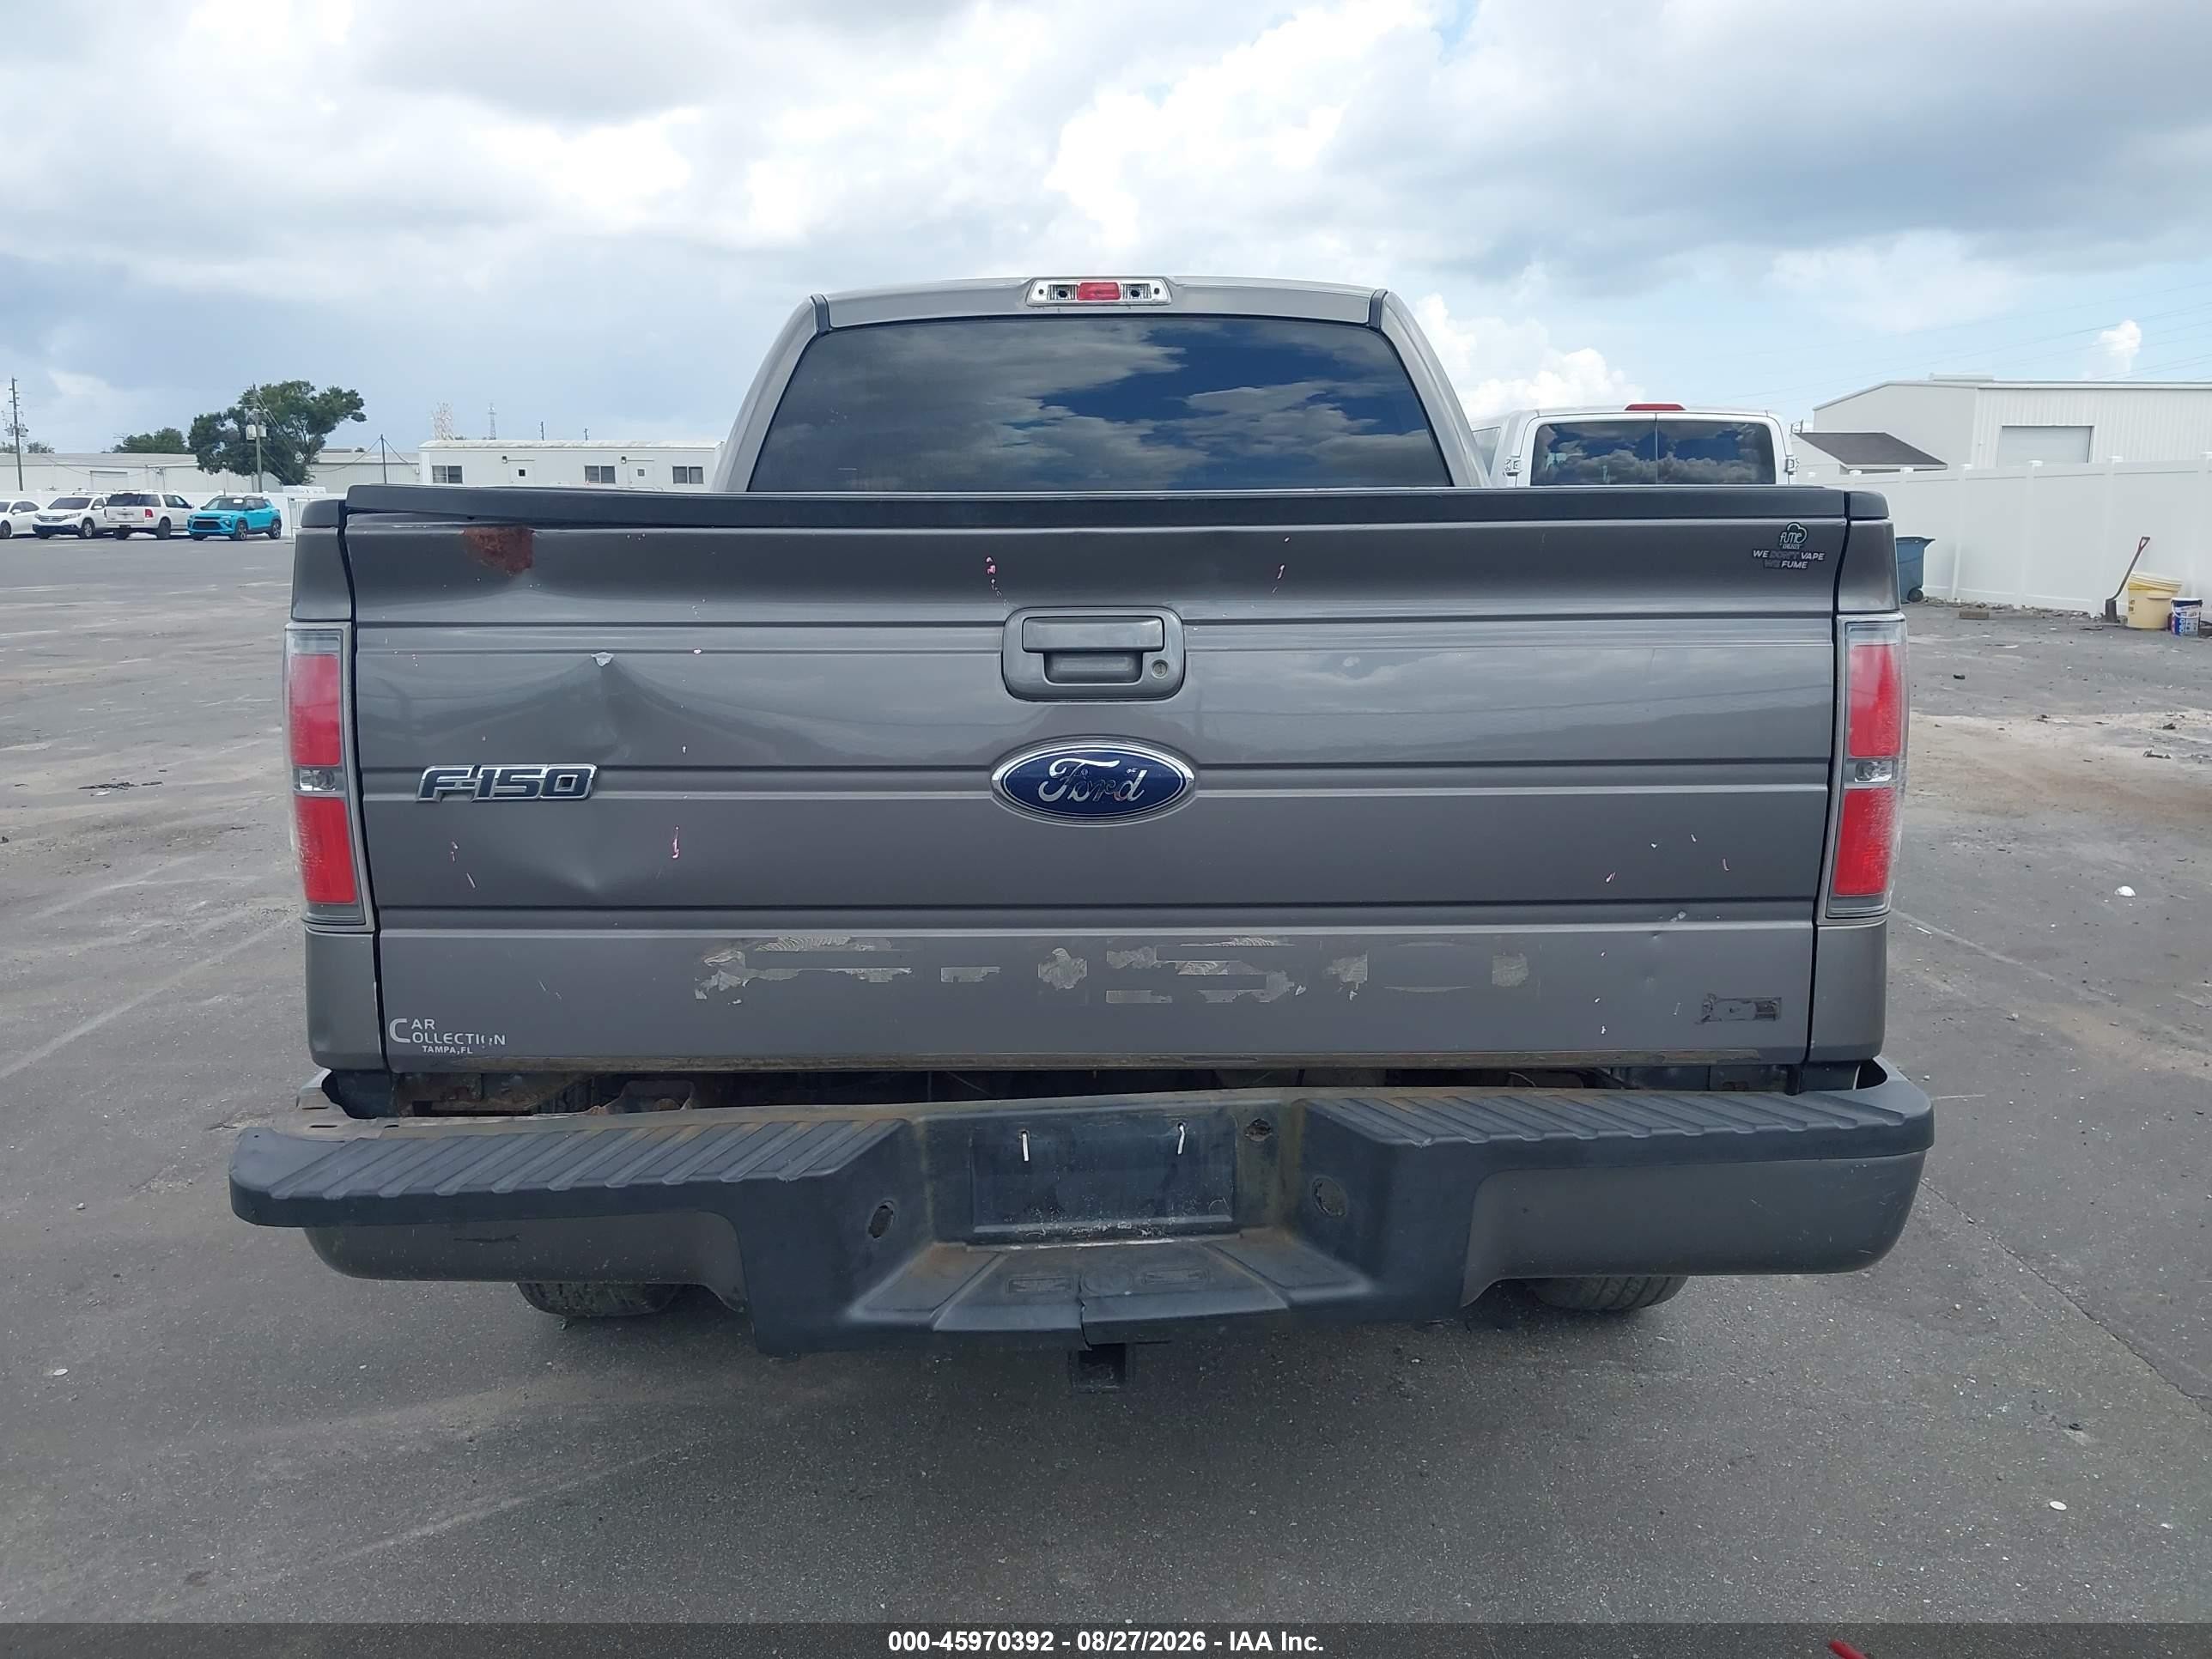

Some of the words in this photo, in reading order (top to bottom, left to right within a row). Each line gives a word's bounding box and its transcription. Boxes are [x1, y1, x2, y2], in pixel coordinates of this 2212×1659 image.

[1753, 550, 1769, 558] WE
[1801, 552, 1825, 561] VAPE
[1781, 560, 1808, 568] FUME
[416, 763, 599, 803] F-150
[1038, 758, 1148, 803] Ford
